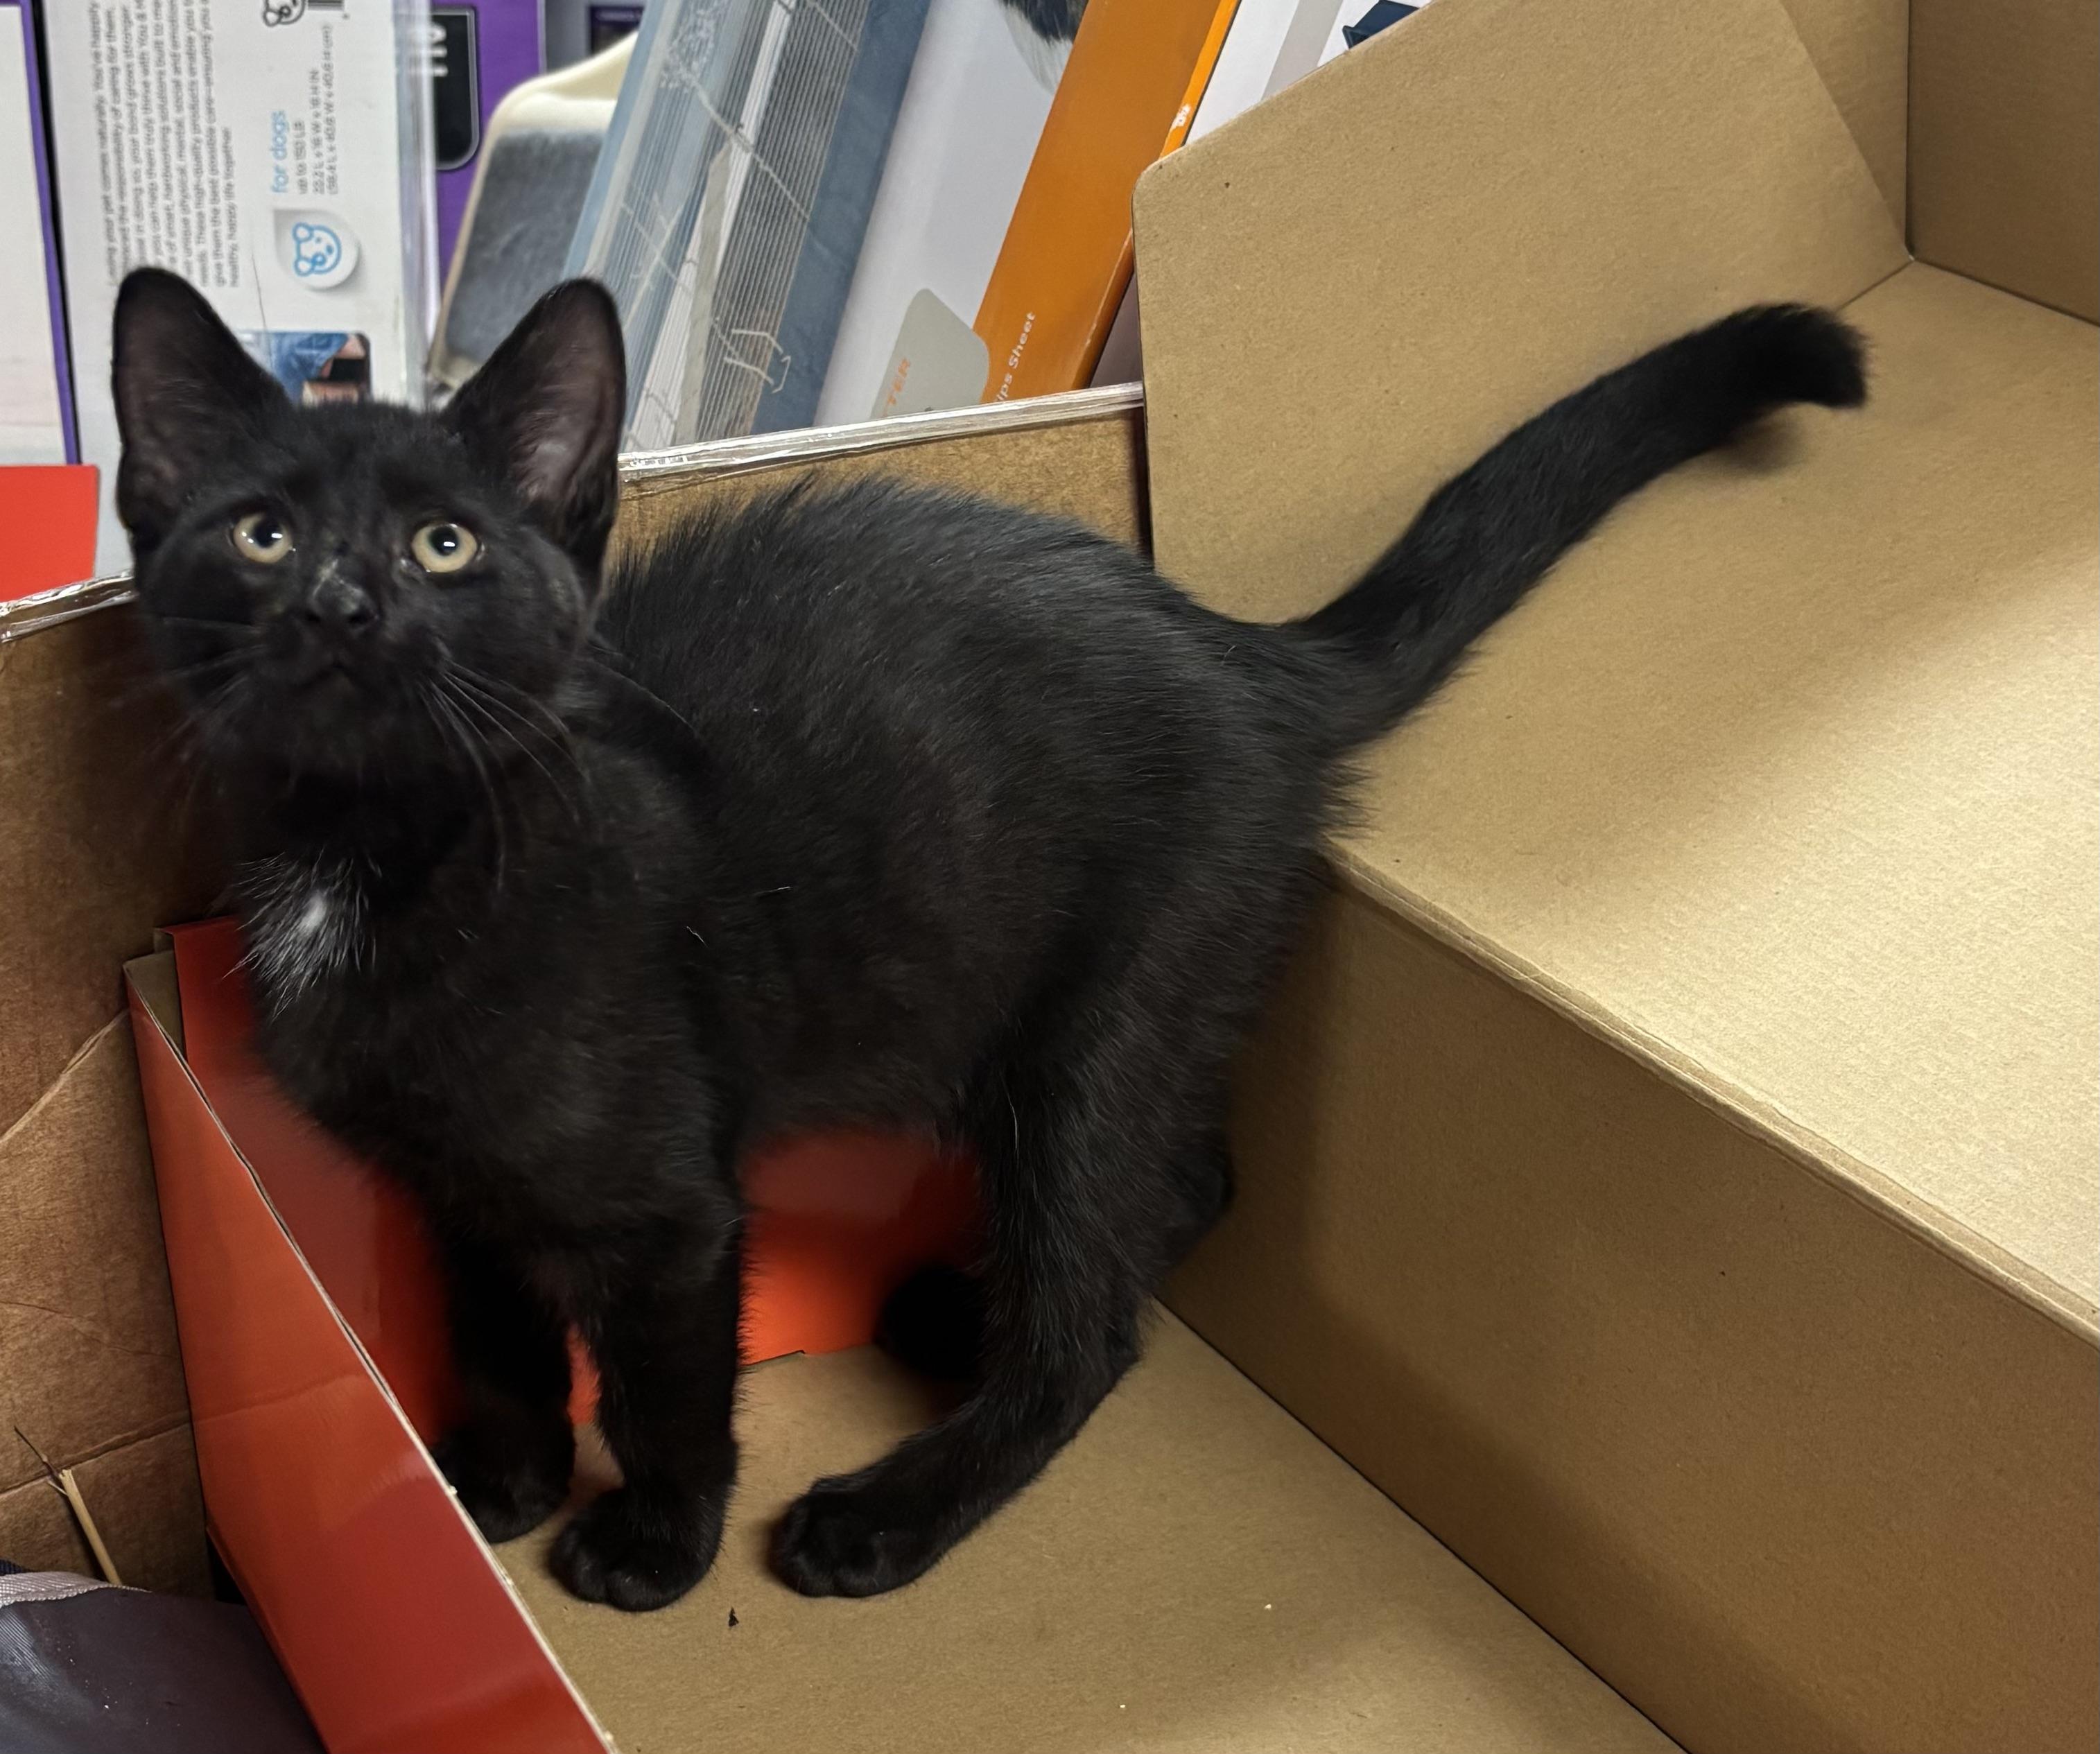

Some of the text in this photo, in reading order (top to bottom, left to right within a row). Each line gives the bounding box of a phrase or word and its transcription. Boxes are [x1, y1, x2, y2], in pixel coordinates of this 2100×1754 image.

[269, 110, 290, 193] for dogs
[102, 194, 114, 214] pet
[1009, 311, 1036, 369] Sheet
